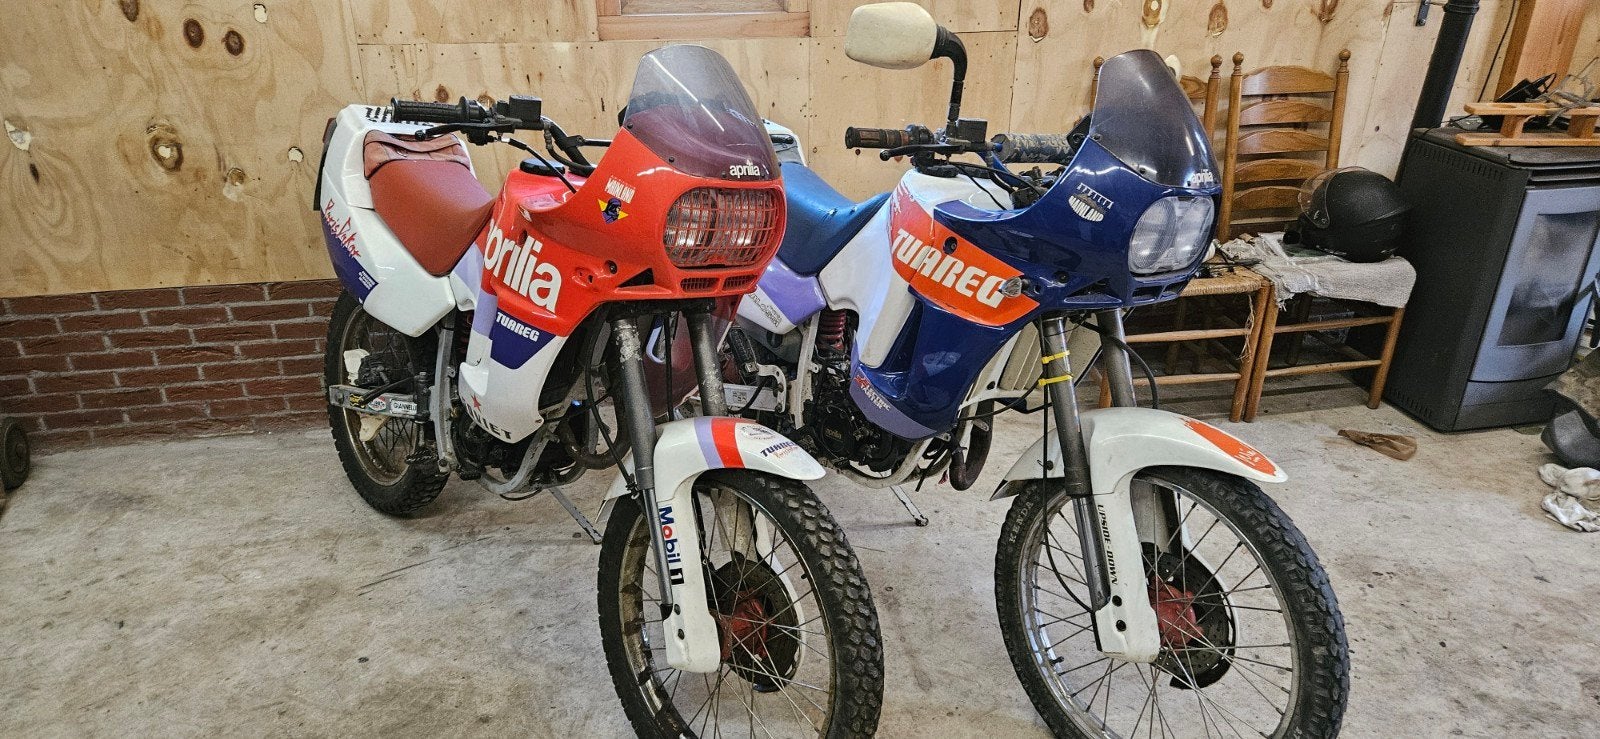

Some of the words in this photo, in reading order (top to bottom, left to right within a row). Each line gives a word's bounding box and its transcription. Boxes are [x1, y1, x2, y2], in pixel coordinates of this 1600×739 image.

[730, 162, 760, 178] aprilia
[1069, 195, 1104, 222] MAINLAND
[484, 219, 562, 313] prilia
[892, 229, 1005, 308] TUAREG
[496, 312, 540, 342] TUAREG
[1009, 500, 1034, 544] KENDA
[659, 505, 681, 564] Mobil
[672, 567, 685, 586] 1
